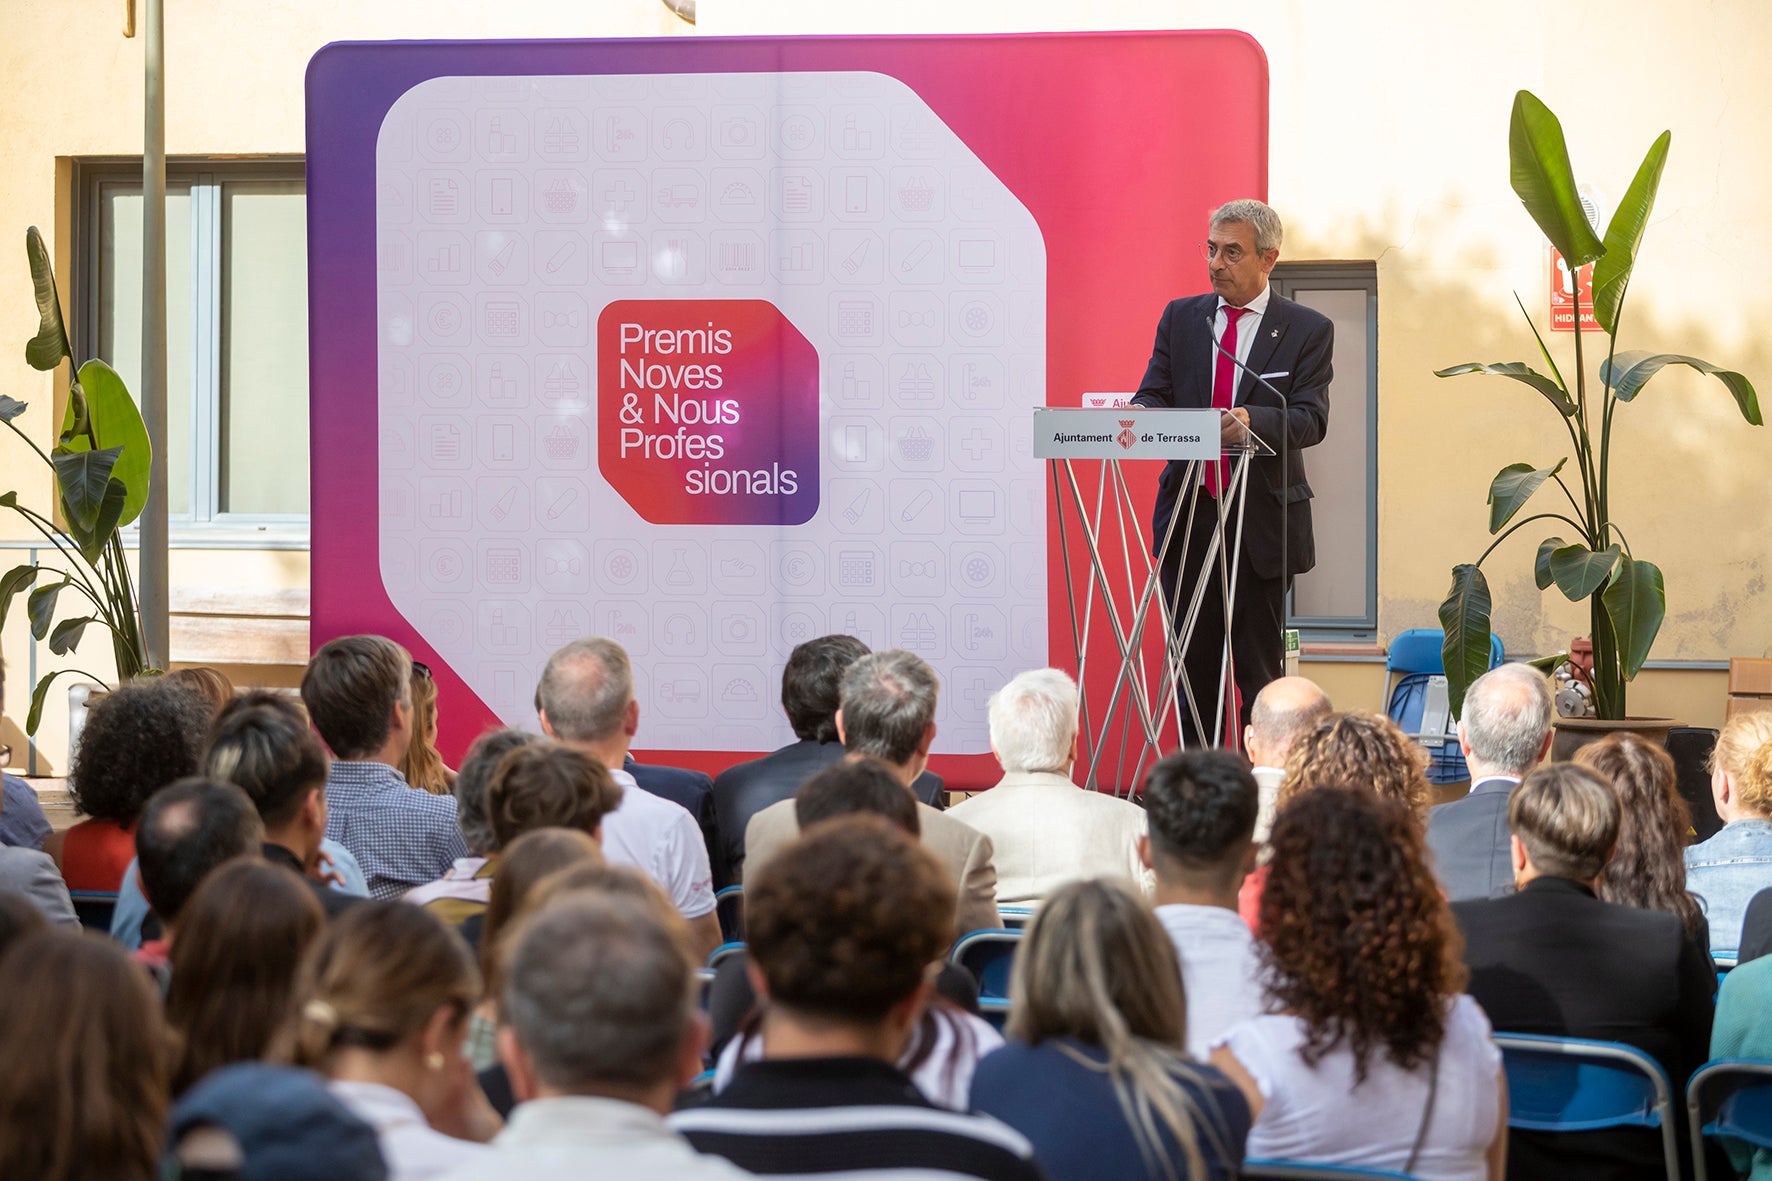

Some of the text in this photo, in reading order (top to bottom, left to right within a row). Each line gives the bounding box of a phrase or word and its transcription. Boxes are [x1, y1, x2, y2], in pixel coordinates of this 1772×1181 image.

[1555, 314, 1597, 323] HIDAN
[620, 322, 733, 354] Premis
[620, 358, 723, 389] Noves
[619, 393, 740, 425] & Nous
[620, 427, 725, 459] Profes
[1053, 433, 1201, 444] Ajuntament de Terrassa
[685, 462, 798, 495] sionals
